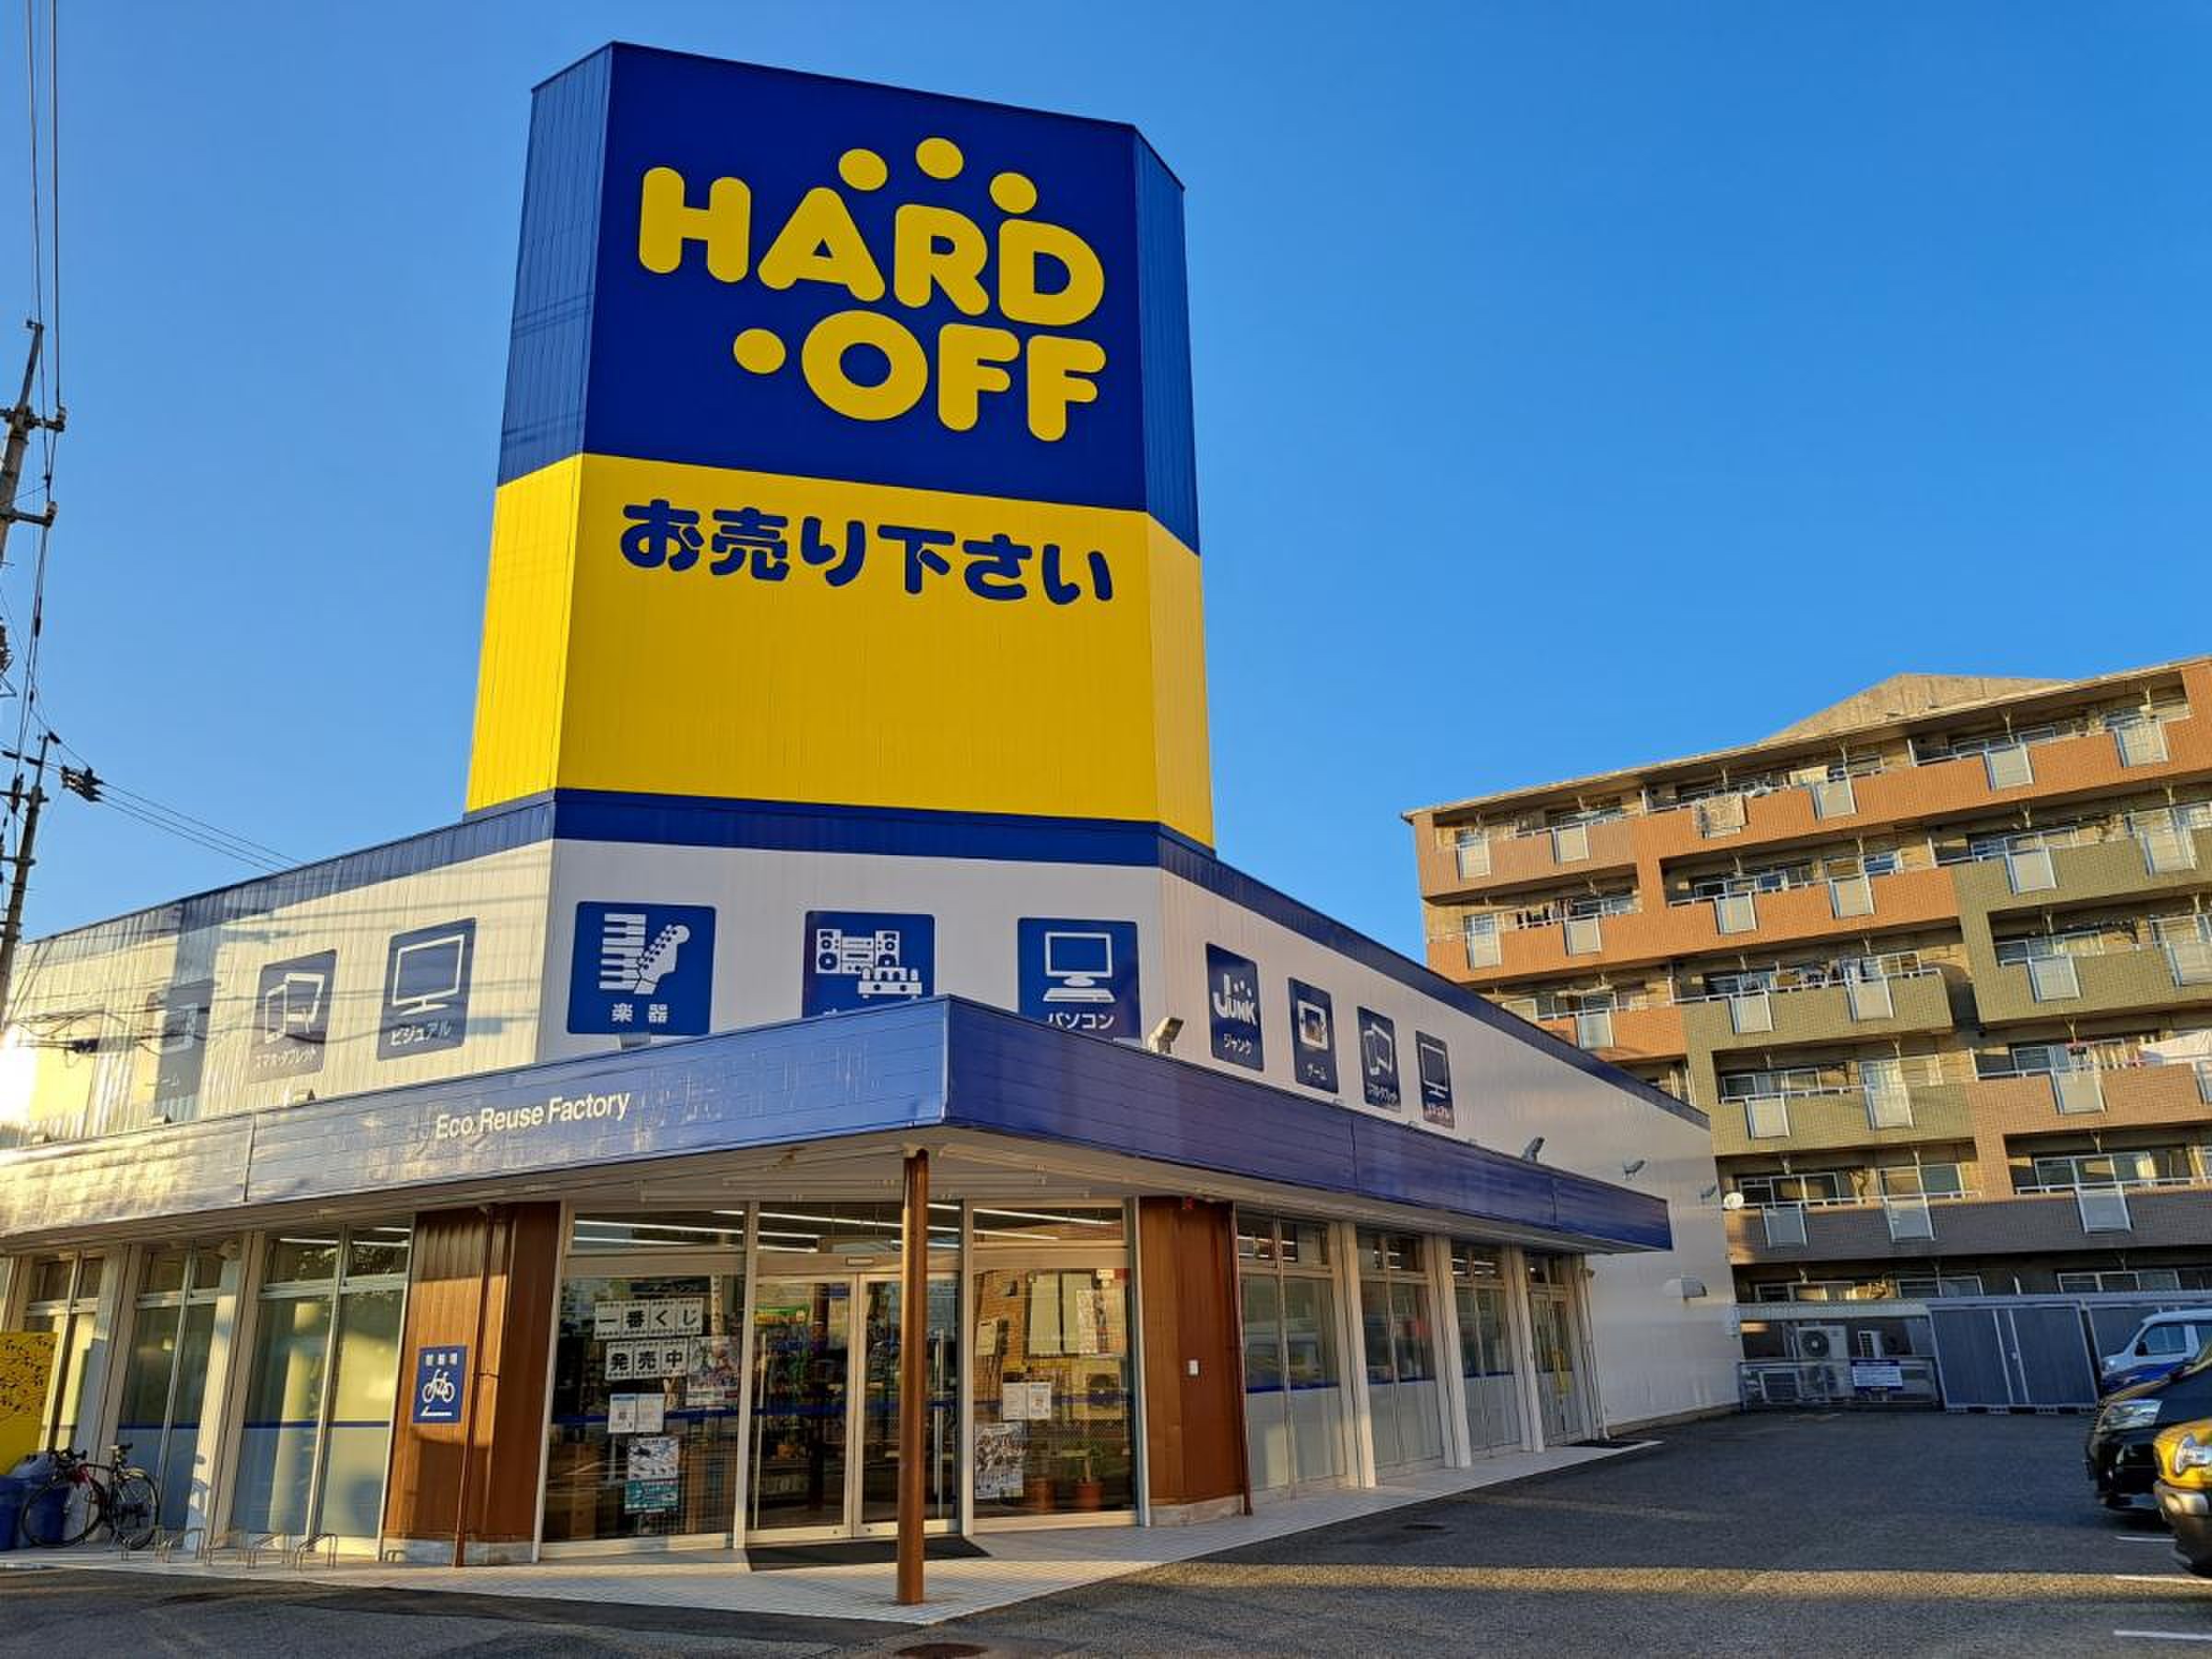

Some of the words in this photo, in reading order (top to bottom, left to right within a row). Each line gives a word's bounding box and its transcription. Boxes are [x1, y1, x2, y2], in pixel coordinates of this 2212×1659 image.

[639, 167, 1105, 325] HARD
[801, 310, 1106, 441] OFF
[620, 499, 1113, 605] お売り下さい
[611, 1003, 669, 1024] 楽器
[1212, 973, 1257, 1026] JUNK
[390, 1019, 454, 1046] ビジュアル
[1048, 1011, 1115, 1030] パソコン
[436, 1113, 474, 1139] Eco
[479, 1104, 545, 1134] Reuse
[547, 1092, 630, 1122] Factory
[598, 1310, 697, 1329] 一番くじ
[610, 1349, 684, 1371] 発売中
